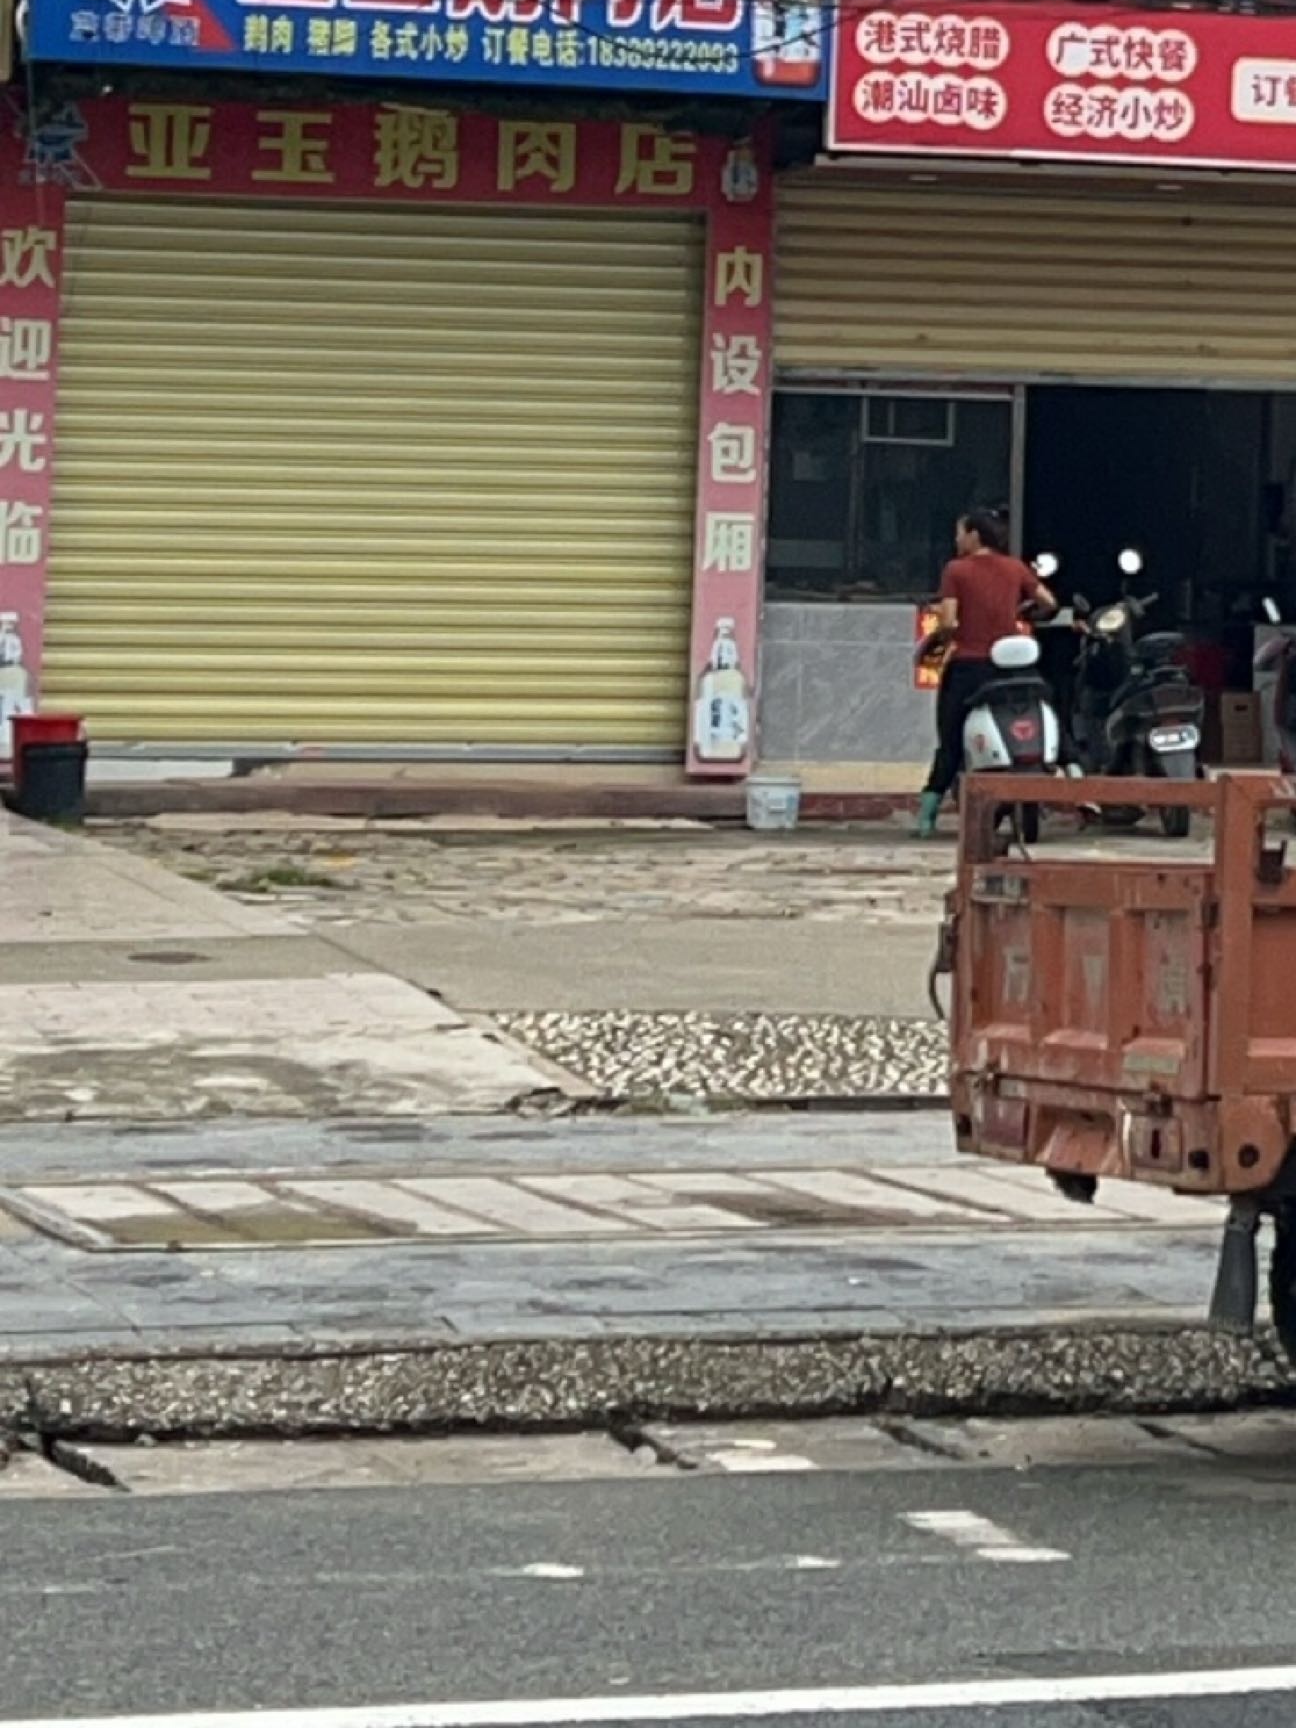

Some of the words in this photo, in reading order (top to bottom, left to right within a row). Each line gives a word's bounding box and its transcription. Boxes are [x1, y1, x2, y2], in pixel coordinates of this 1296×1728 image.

[371, 21, 469, 63] 各式小炒
[863, 20, 1001, 60] 港式烧腊
[1056, 32, 1187, 72] 广式快餐
[862, 79, 1000, 120] 潮汕卤味
[1051, 92, 1187, 130] 经济小炒
[126, 102, 697, 197] 亚玉鹅肉店
[0, 225, 57, 565] 欢迎光临
[703, 246, 764, 572] 内设包厢
